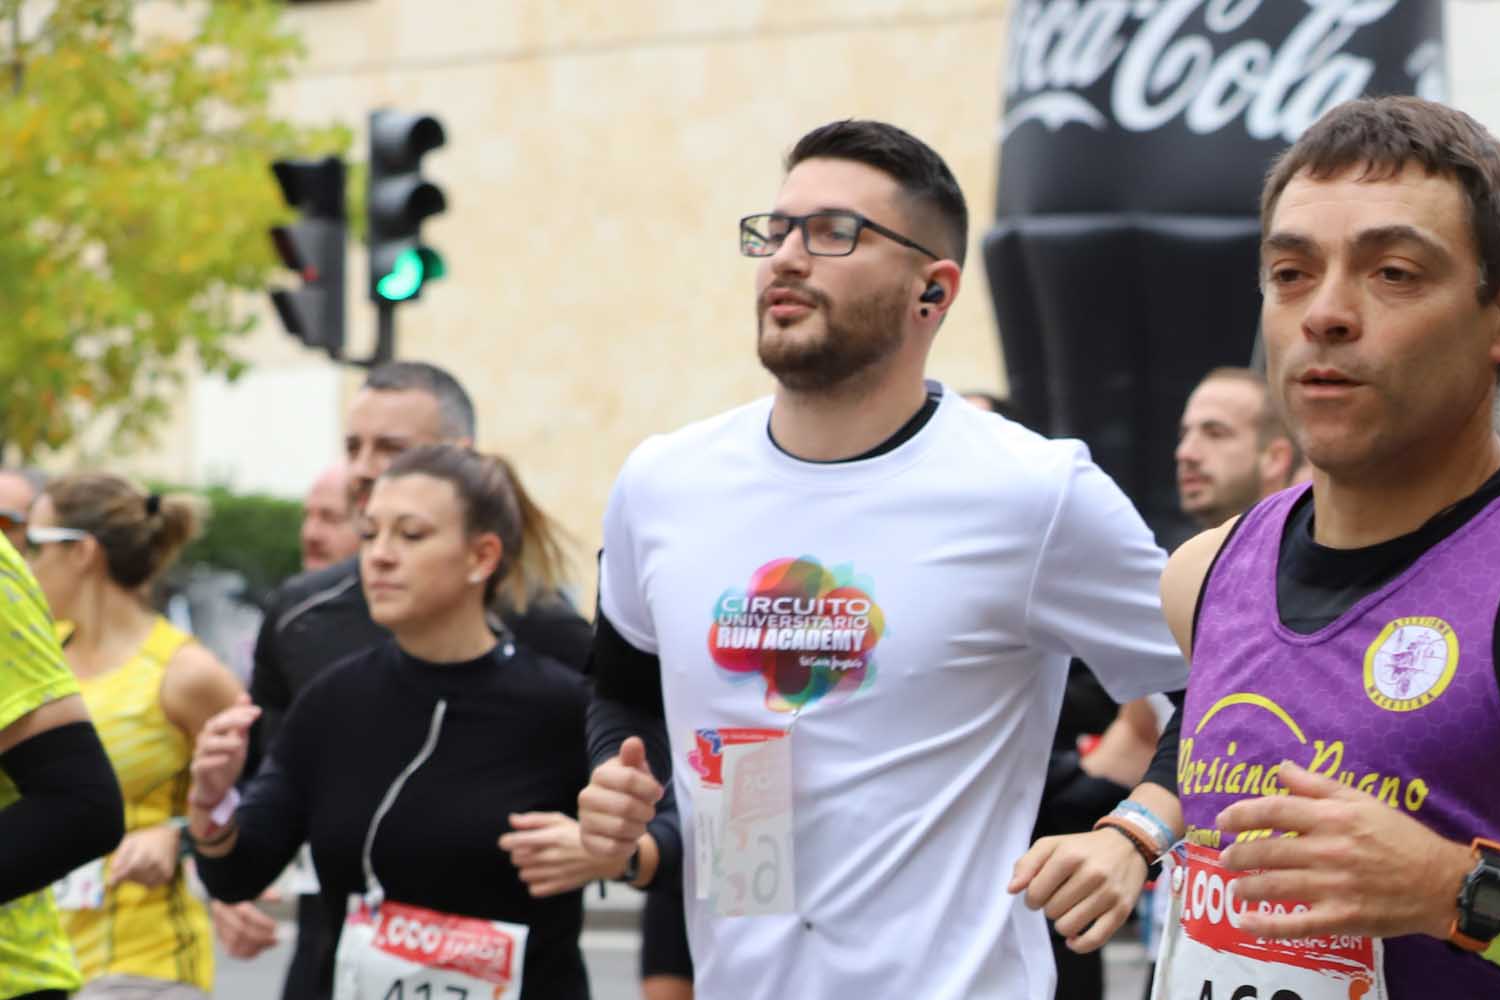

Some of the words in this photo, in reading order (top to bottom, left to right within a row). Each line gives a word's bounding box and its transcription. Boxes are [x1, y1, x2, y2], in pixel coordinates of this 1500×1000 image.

[721, 596, 873, 616] CIRCUITO
[718, 613, 870, 630] UNIVERSITARIO
[716, 626, 763, 650] RUN
[762, 628, 868, 652] ACADEMY
